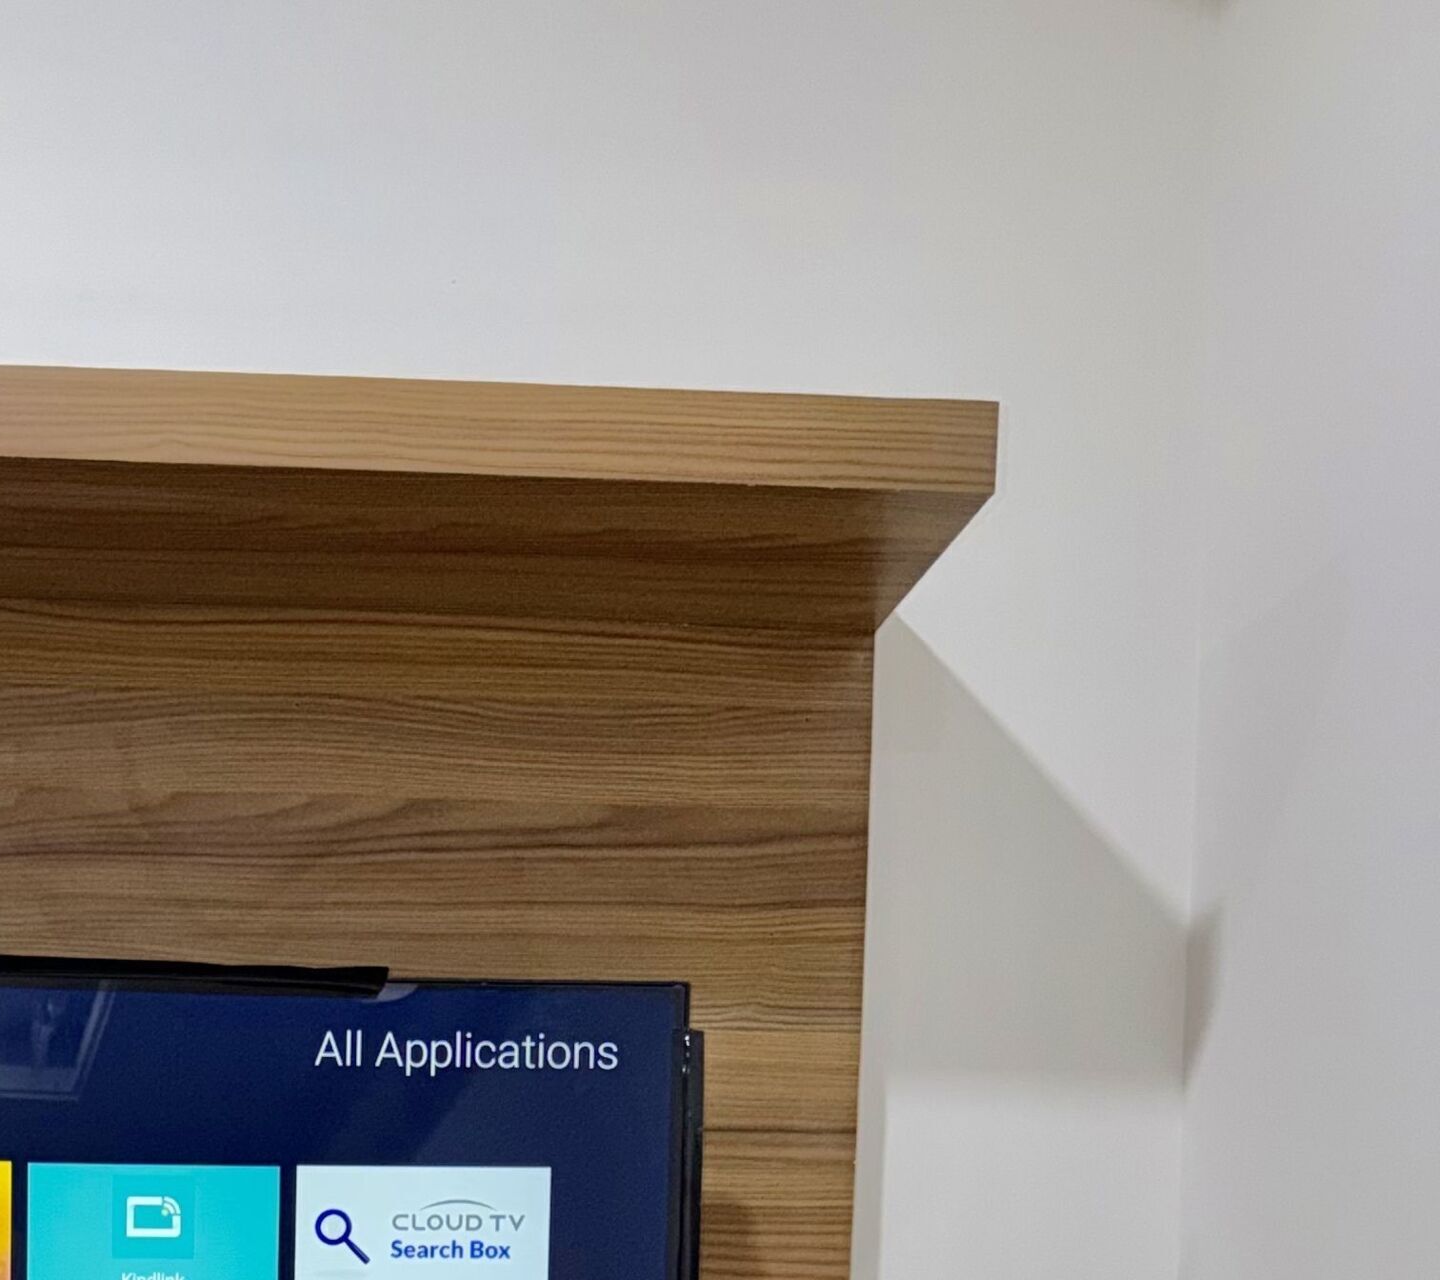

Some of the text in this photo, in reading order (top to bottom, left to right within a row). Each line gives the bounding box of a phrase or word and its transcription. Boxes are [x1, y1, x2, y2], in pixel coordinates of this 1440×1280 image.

[314, 1029, 620, 1076] All Applications
[391, 1212, 526, 1233] CLOUD TV
[390, 1239, 511, 1260] Search Box
